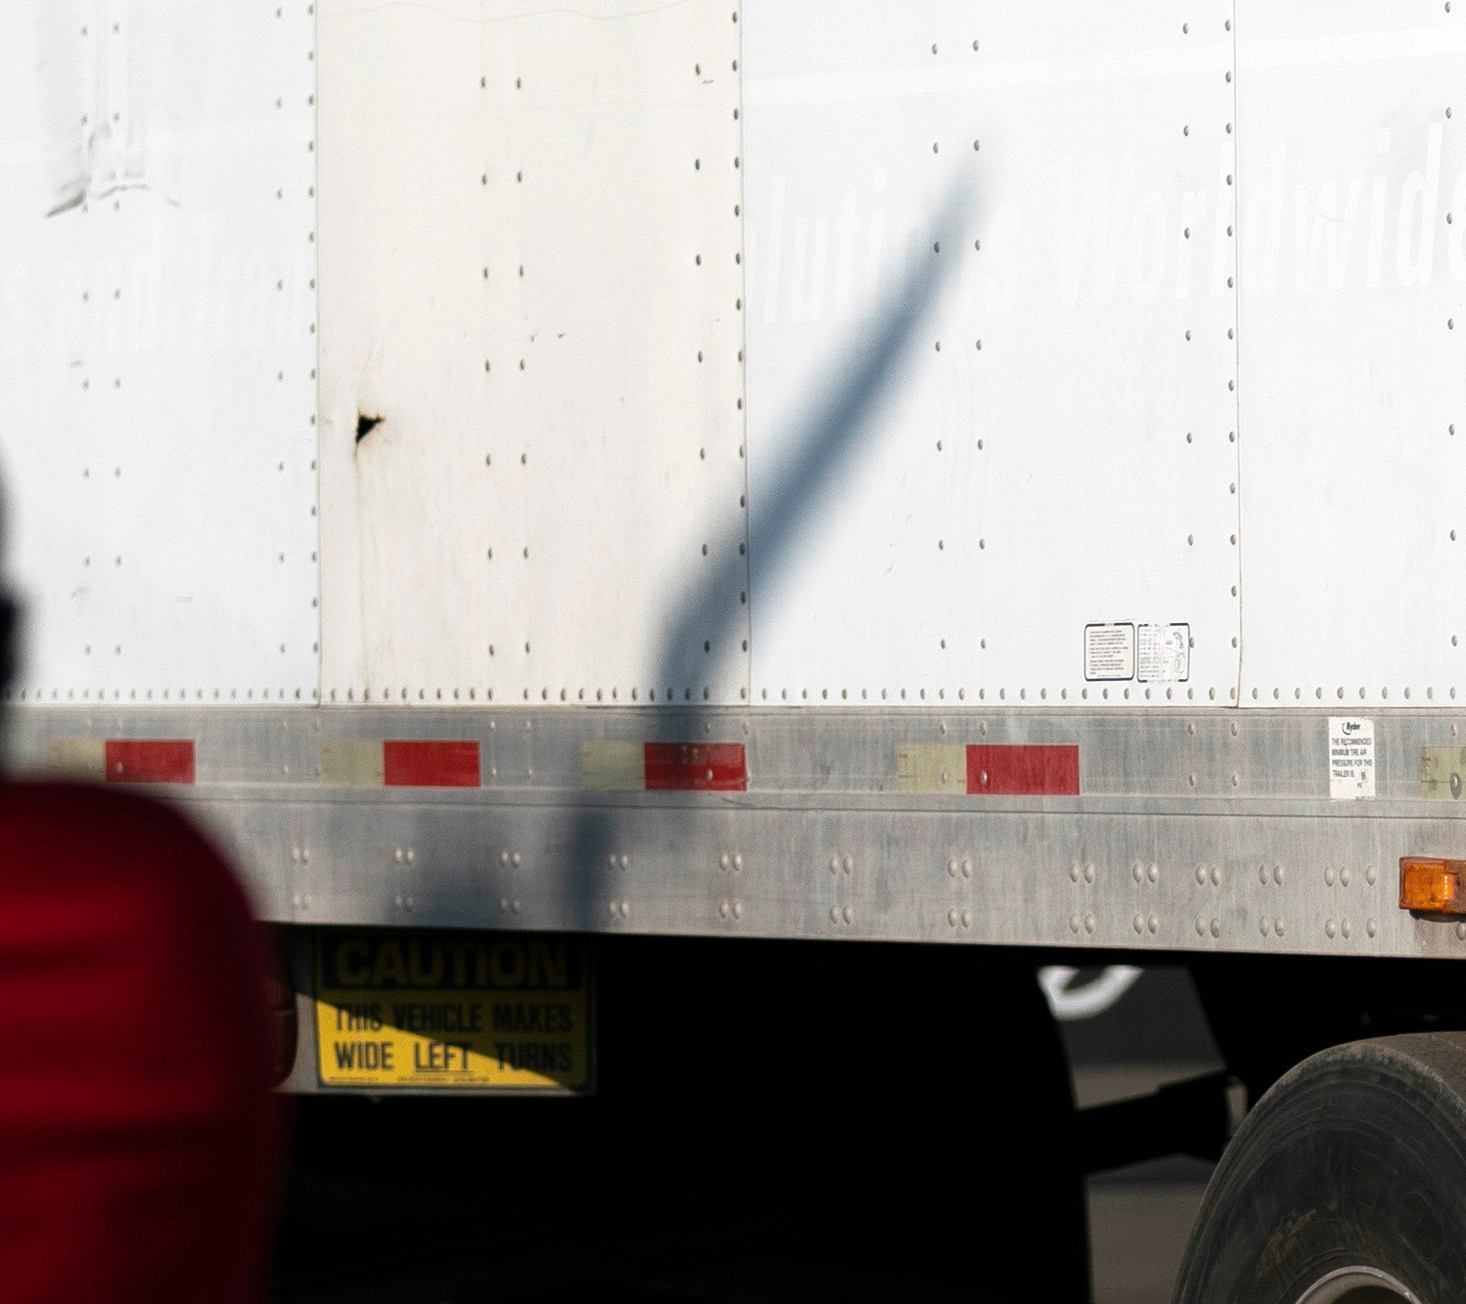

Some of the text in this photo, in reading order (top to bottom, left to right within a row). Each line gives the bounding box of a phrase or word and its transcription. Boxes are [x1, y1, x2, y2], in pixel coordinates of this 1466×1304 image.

[336, 938, 568, 987] CAUTION
[335, 1002, 573, 1032] THIS VEHICLE MAKES
[334, 1042, 573, 1071] WIDE LEFT TURNS
